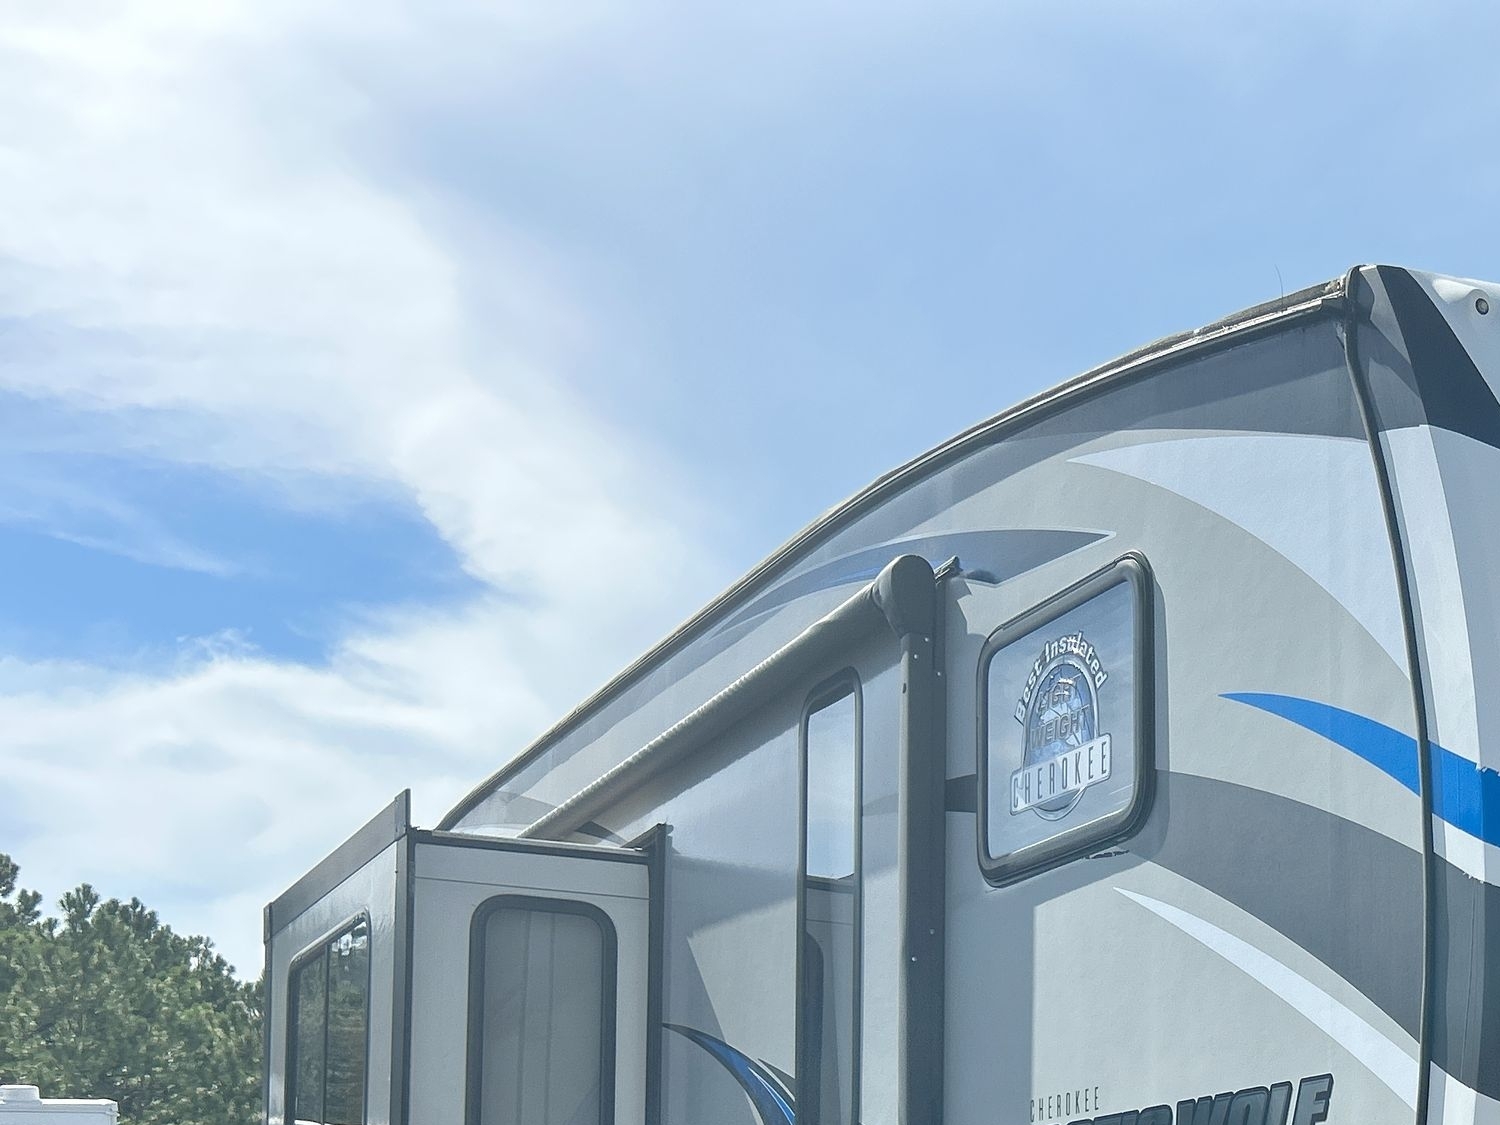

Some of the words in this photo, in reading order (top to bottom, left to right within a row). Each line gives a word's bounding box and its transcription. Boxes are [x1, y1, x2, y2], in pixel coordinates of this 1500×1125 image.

[1014, 657, 1043, 727] Best
[1044, 630, 1109, 691] Insulated
[1013, 741, 1108, 809] CHEROKEE
[1030, 1086, 1100, 1123] CHEROKEE
